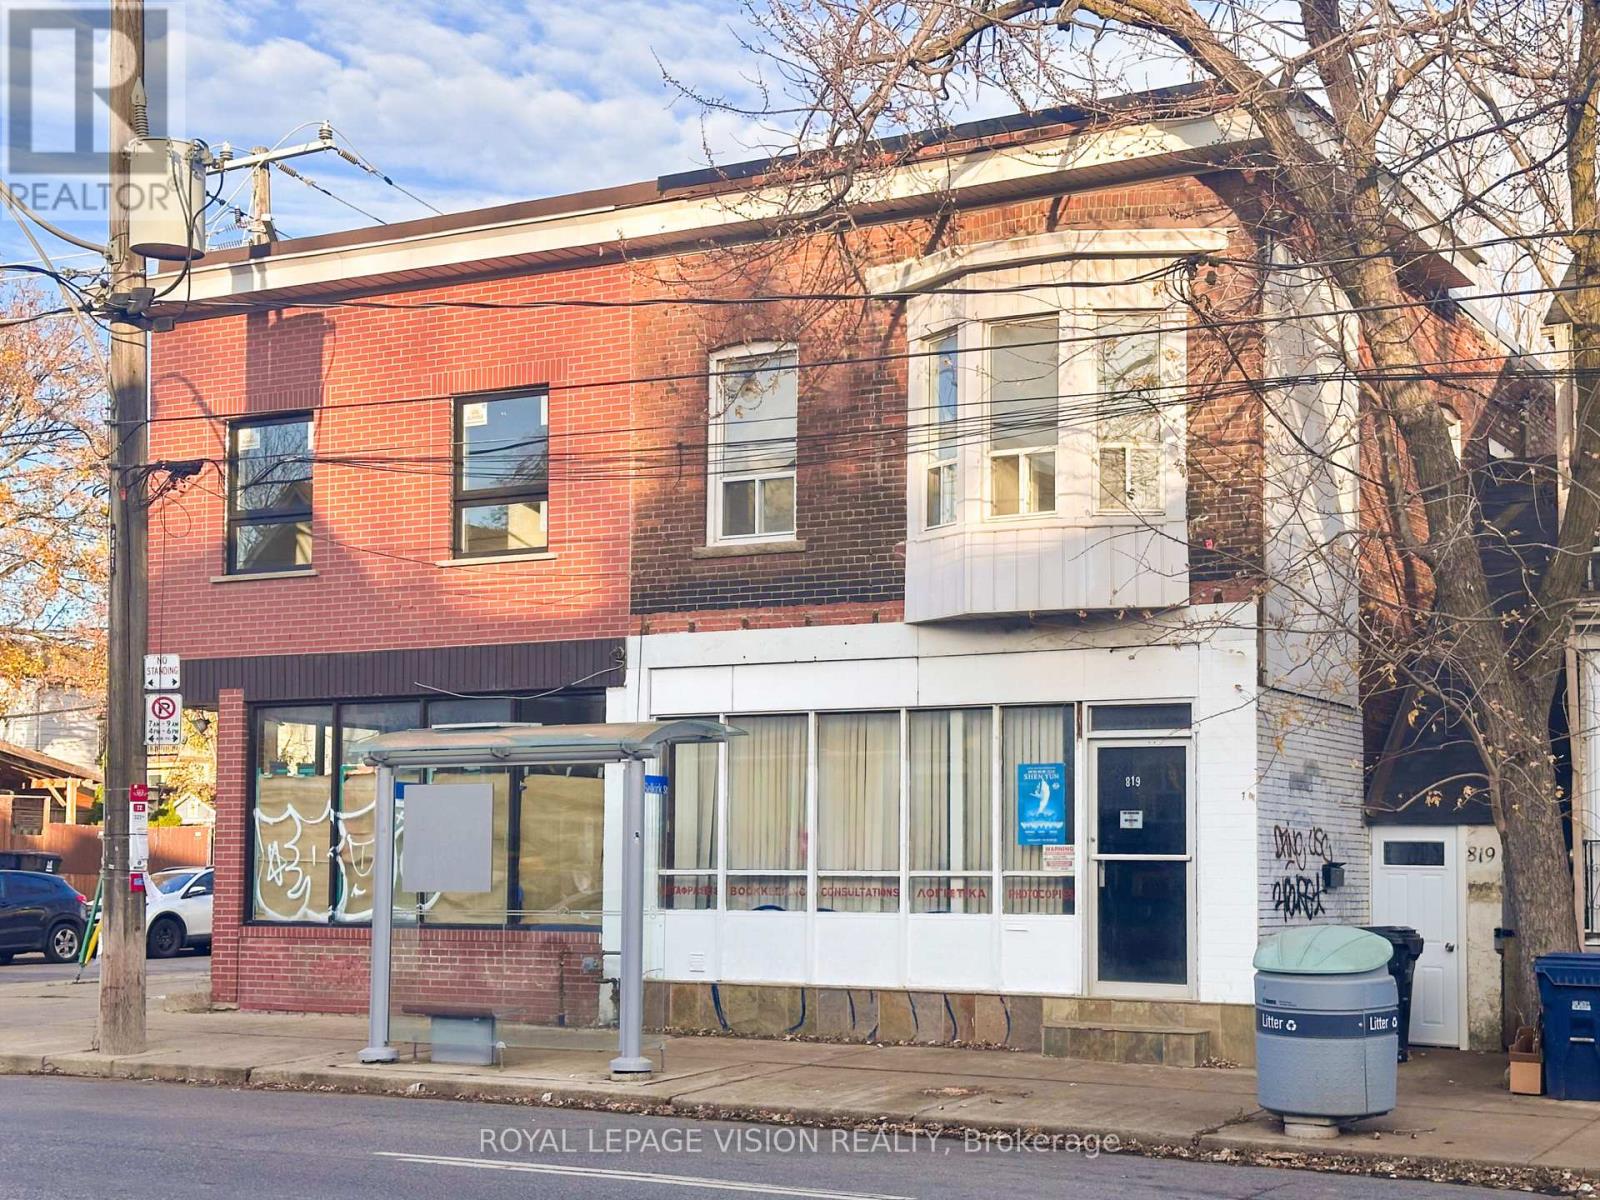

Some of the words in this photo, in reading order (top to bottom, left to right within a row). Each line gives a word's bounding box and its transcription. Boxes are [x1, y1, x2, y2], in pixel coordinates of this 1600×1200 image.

[156, 656, 168, 665] NO
[146, 666, 178, 676] STANDING
[1125, 775, 1141, 788] 819
[1467, 846, 1496, 863] 819
[821, 887, 900, 897] CONSULTATIONS
[1262, 1013, 1284, 1030] Litter
[1369, 1016, 1389, 1031] Litter
